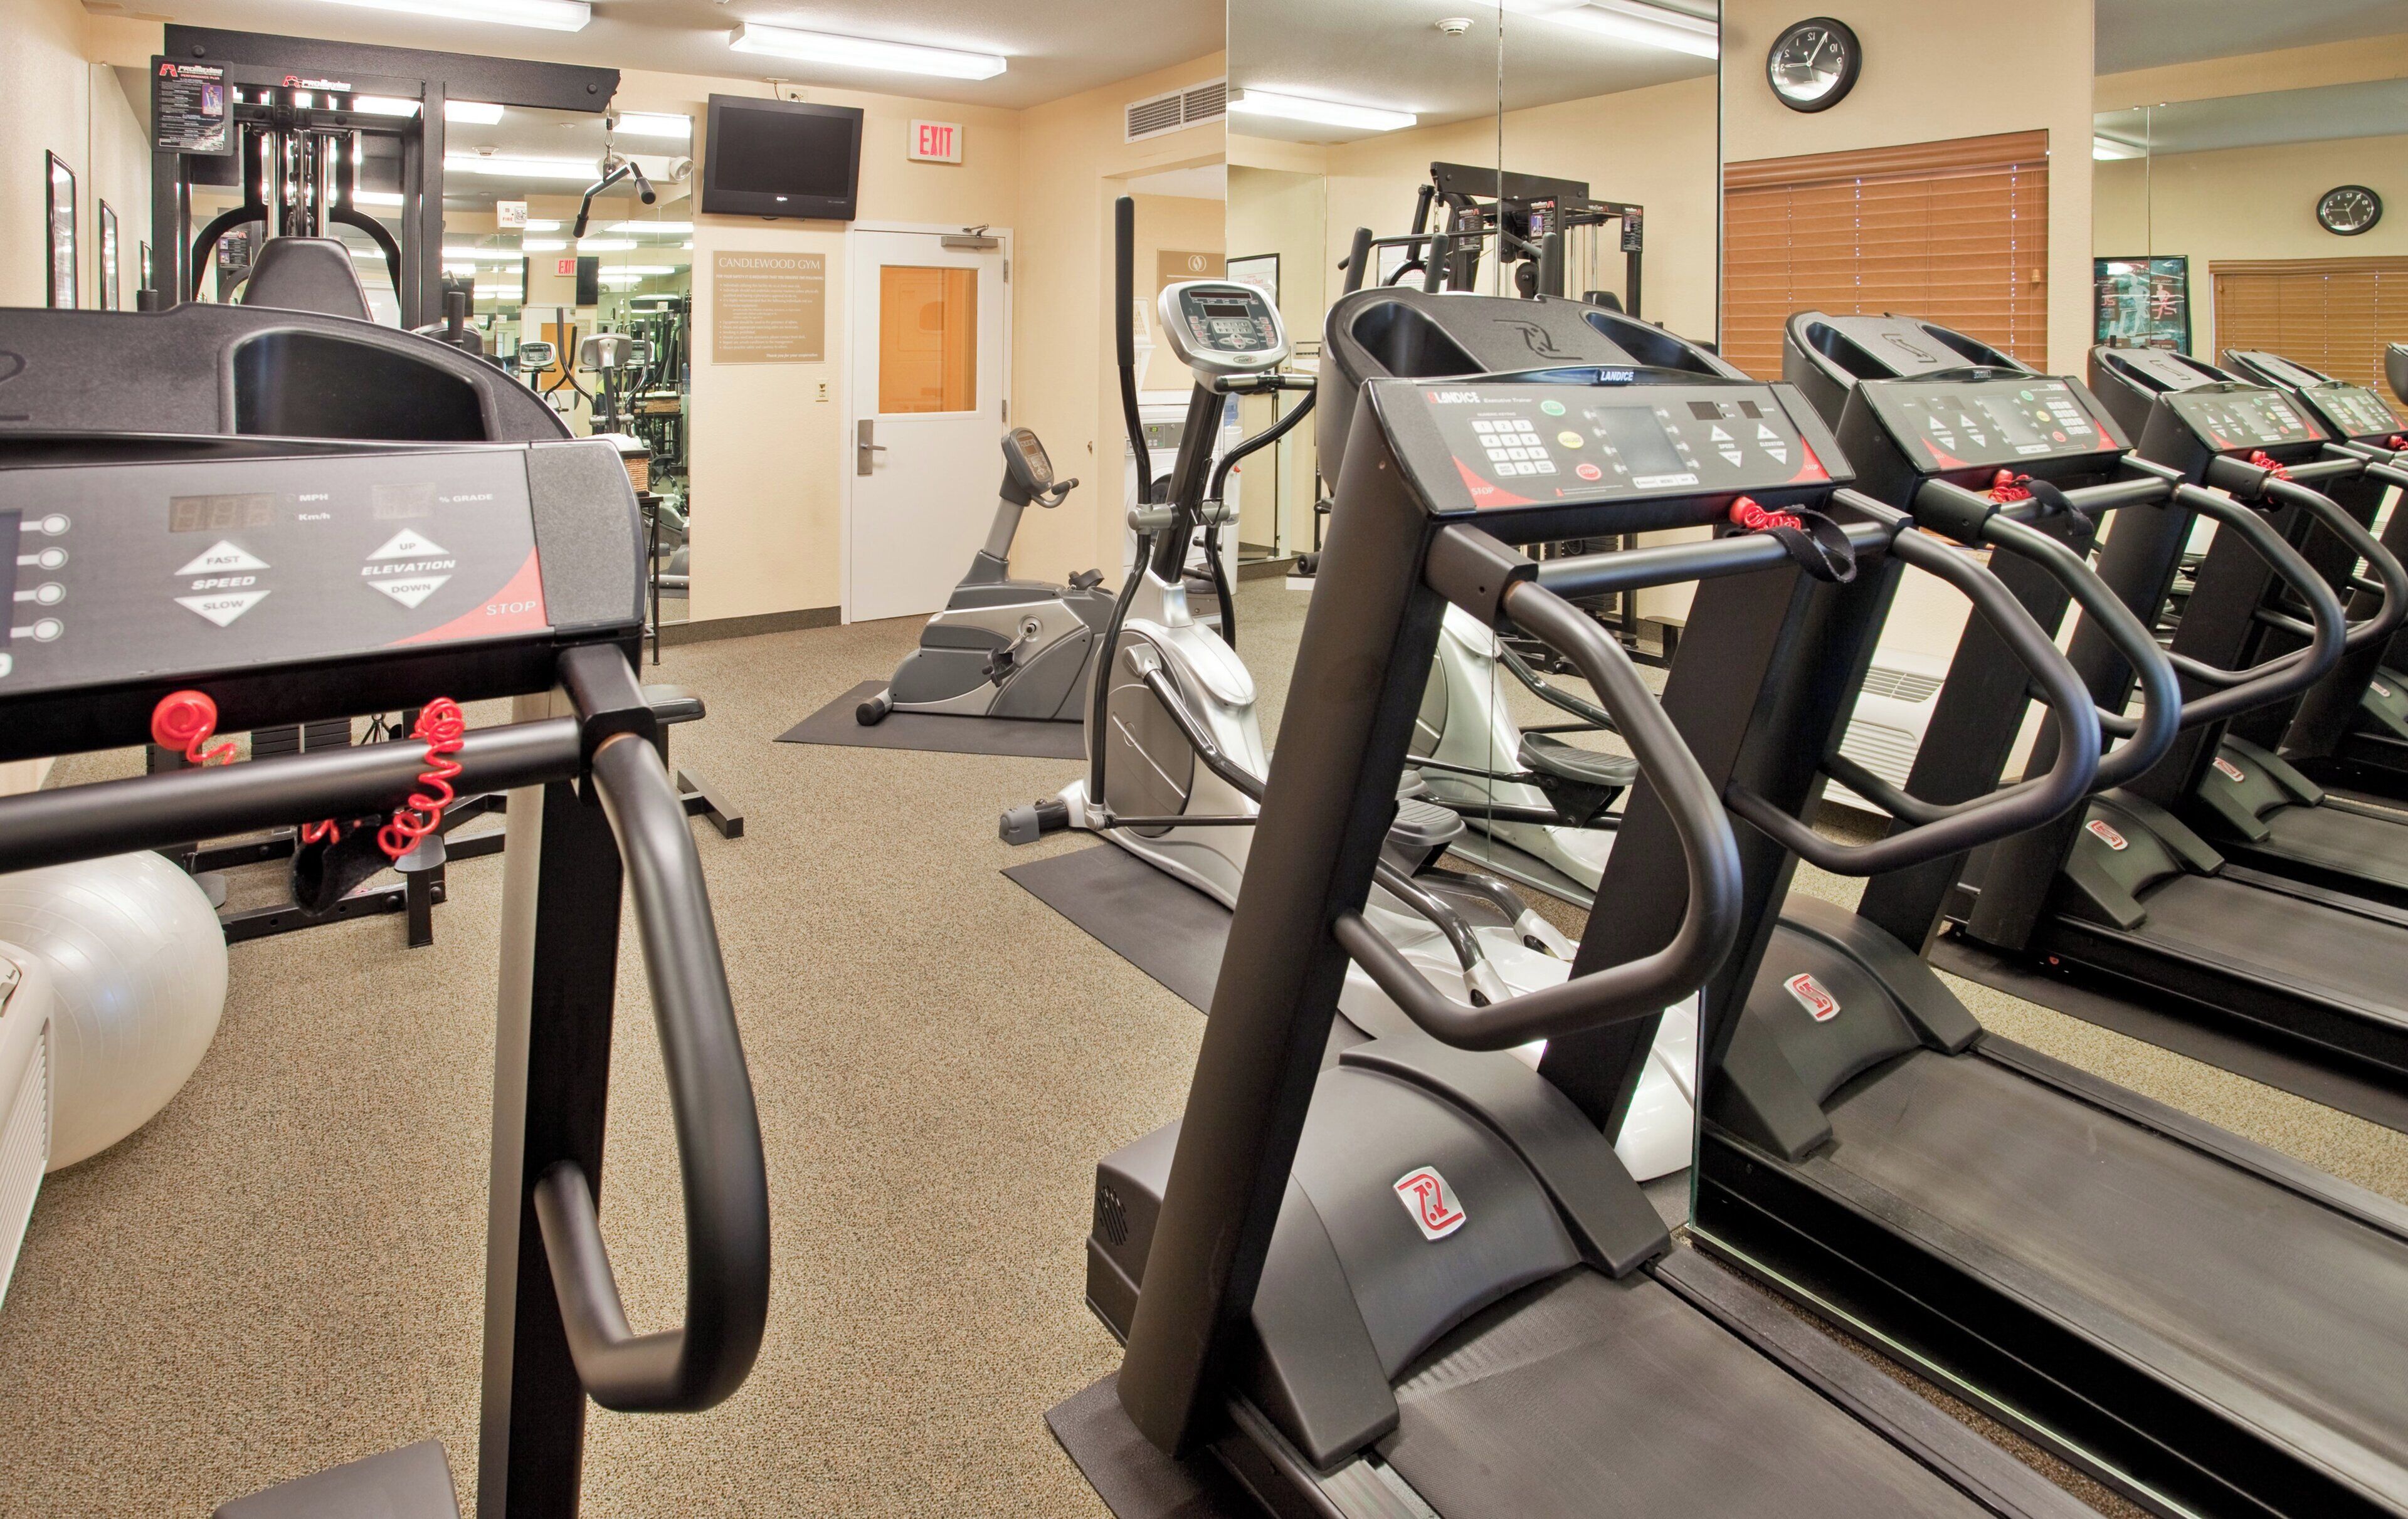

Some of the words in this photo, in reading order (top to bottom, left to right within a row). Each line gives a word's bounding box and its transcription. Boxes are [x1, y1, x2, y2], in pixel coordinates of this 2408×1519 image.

[920, 125, 953, 157] EXIT
[558, 260, 576, 274] EXIT
[719, 258, 795, 269] CANDLEWOOD
[798, 260, 820, 270] GYM
[1600, 371, 1634, 381] LANDICE
[1434, 391, 1481, 404] LANDICE
[1472, 487, 1494, 495] STOP
[453, 494, 493, 502] GRADE
[298, 513, 330, 522] Km/h
[206, 555, 240, 565] FAST
[361, 560, 456, 576] ELEVATION
[191, 576, 256, 591] SPEED
[391, 584, 431, 593] DOWN
[203, 600, 244, 611] SLOW
[486, 601, 536, 616] STOP
